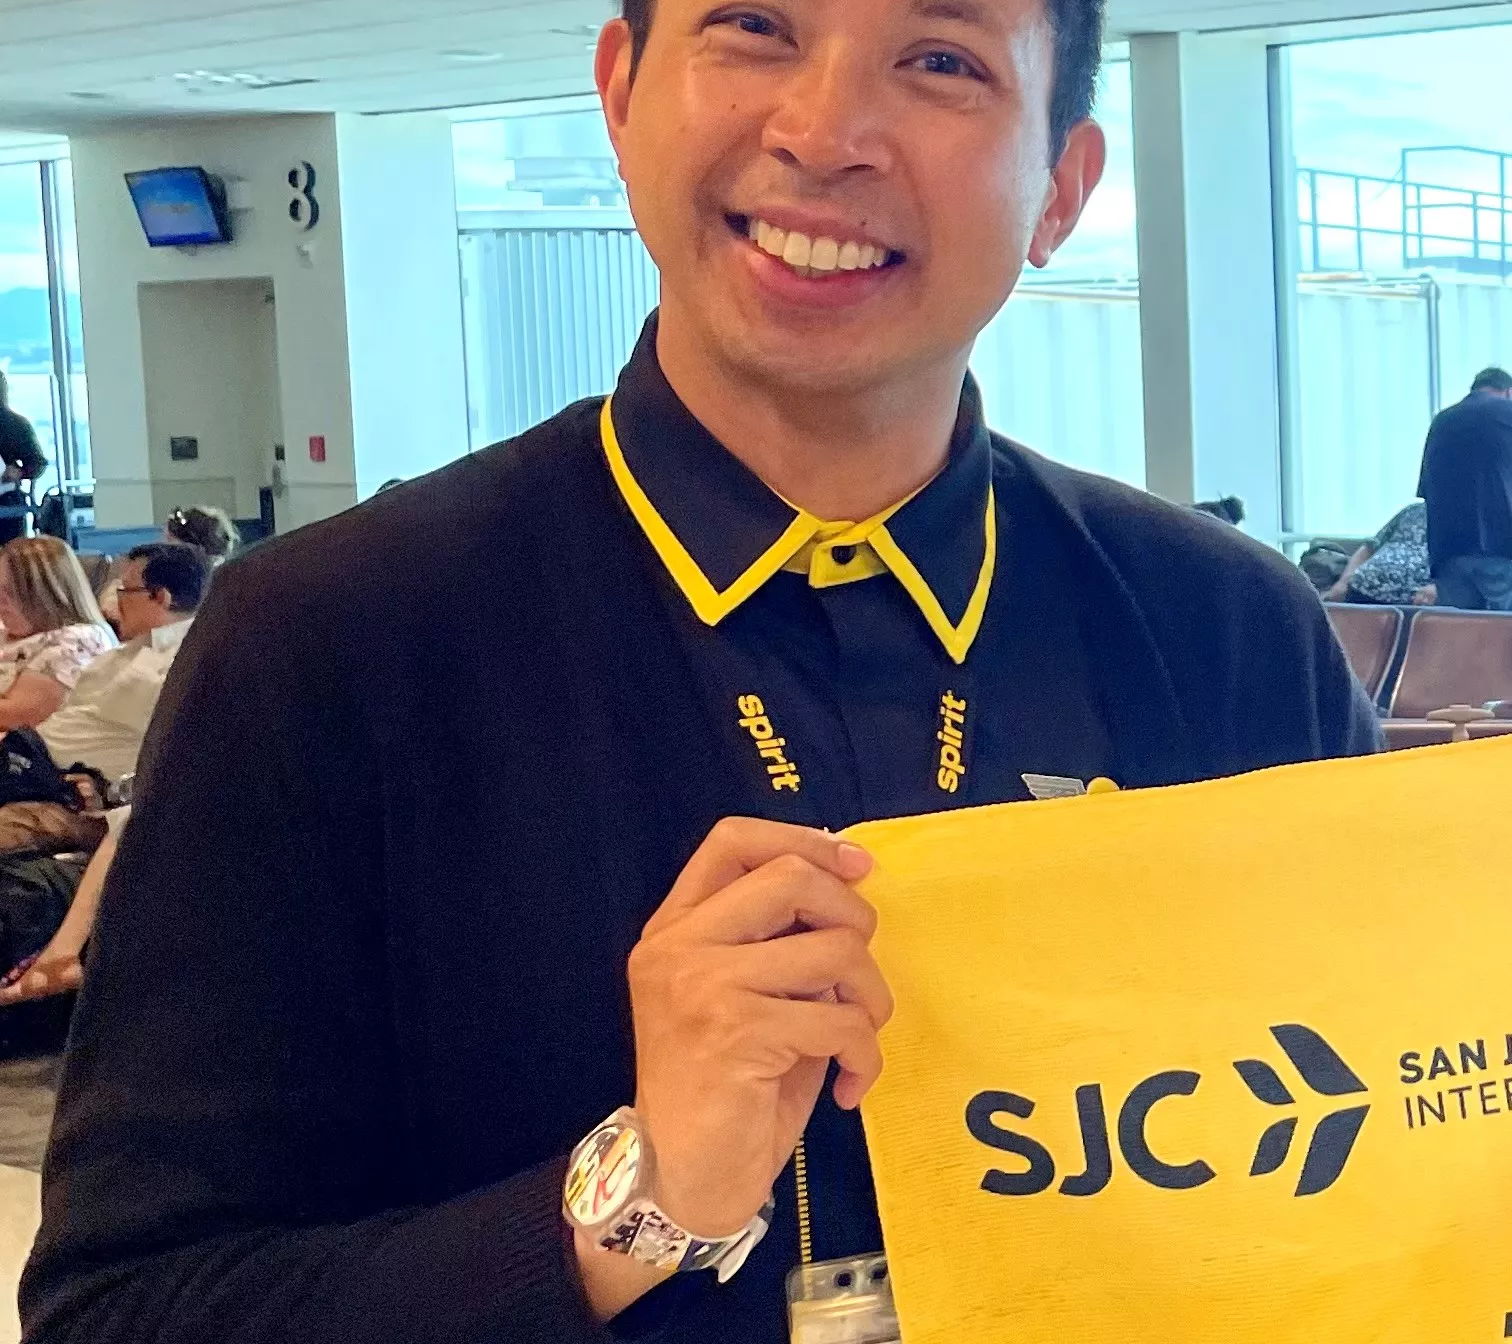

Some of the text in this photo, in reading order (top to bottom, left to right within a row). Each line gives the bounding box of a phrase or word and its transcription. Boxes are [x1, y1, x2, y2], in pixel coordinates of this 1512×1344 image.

[285, 159, 319, 233] 8
[737, 694, 801, 792] spirit
[936, 689, 967, 794] spirit
[1399, 1038, 1489, 1085] SAN
[964, 1070, 1217, 1197] SJC
